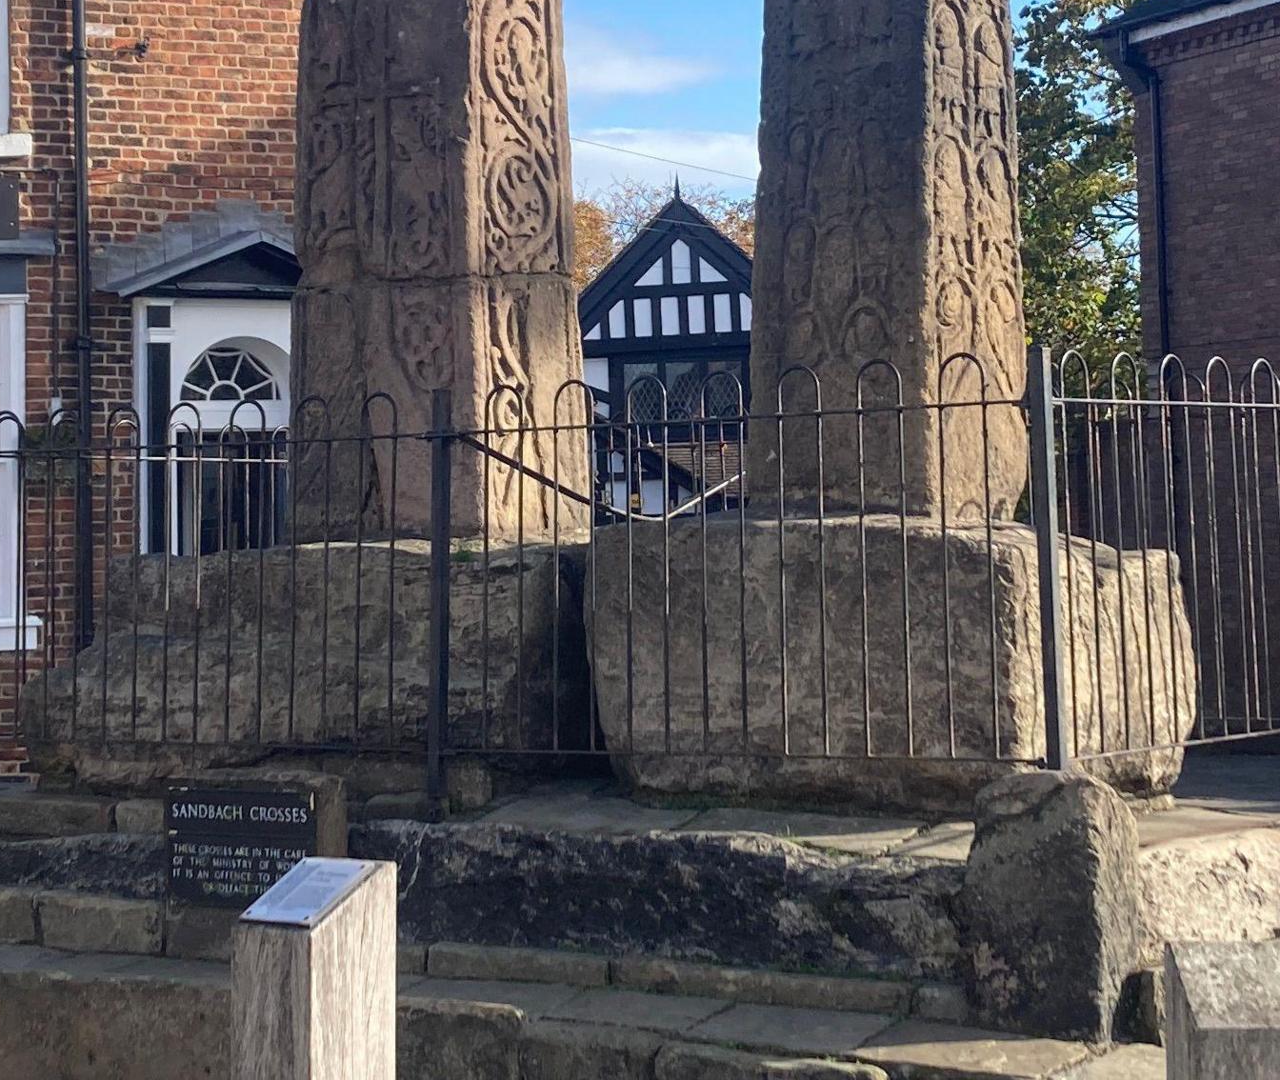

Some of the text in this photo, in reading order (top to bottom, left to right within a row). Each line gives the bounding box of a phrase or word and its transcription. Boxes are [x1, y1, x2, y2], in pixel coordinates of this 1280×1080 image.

[172, 803, 308, 823] SANDBACH CROSSES
[234, 846, 249, 856] ARE
[252, 848, 262, 857] IN
[265, 848, 281, 858] THE
[172, 855, 184, 866] OF
[212, 857, 253, 869] MINISTRY
[259, 860, 270, 870] OF
[172, 868, 181, 879] IT
[185, 868, 194, 879] IS
[197, 870, 210, 880] AN
[214, 870, 252, 882] OFFENCE
[258, 872, 271, 883] TO
